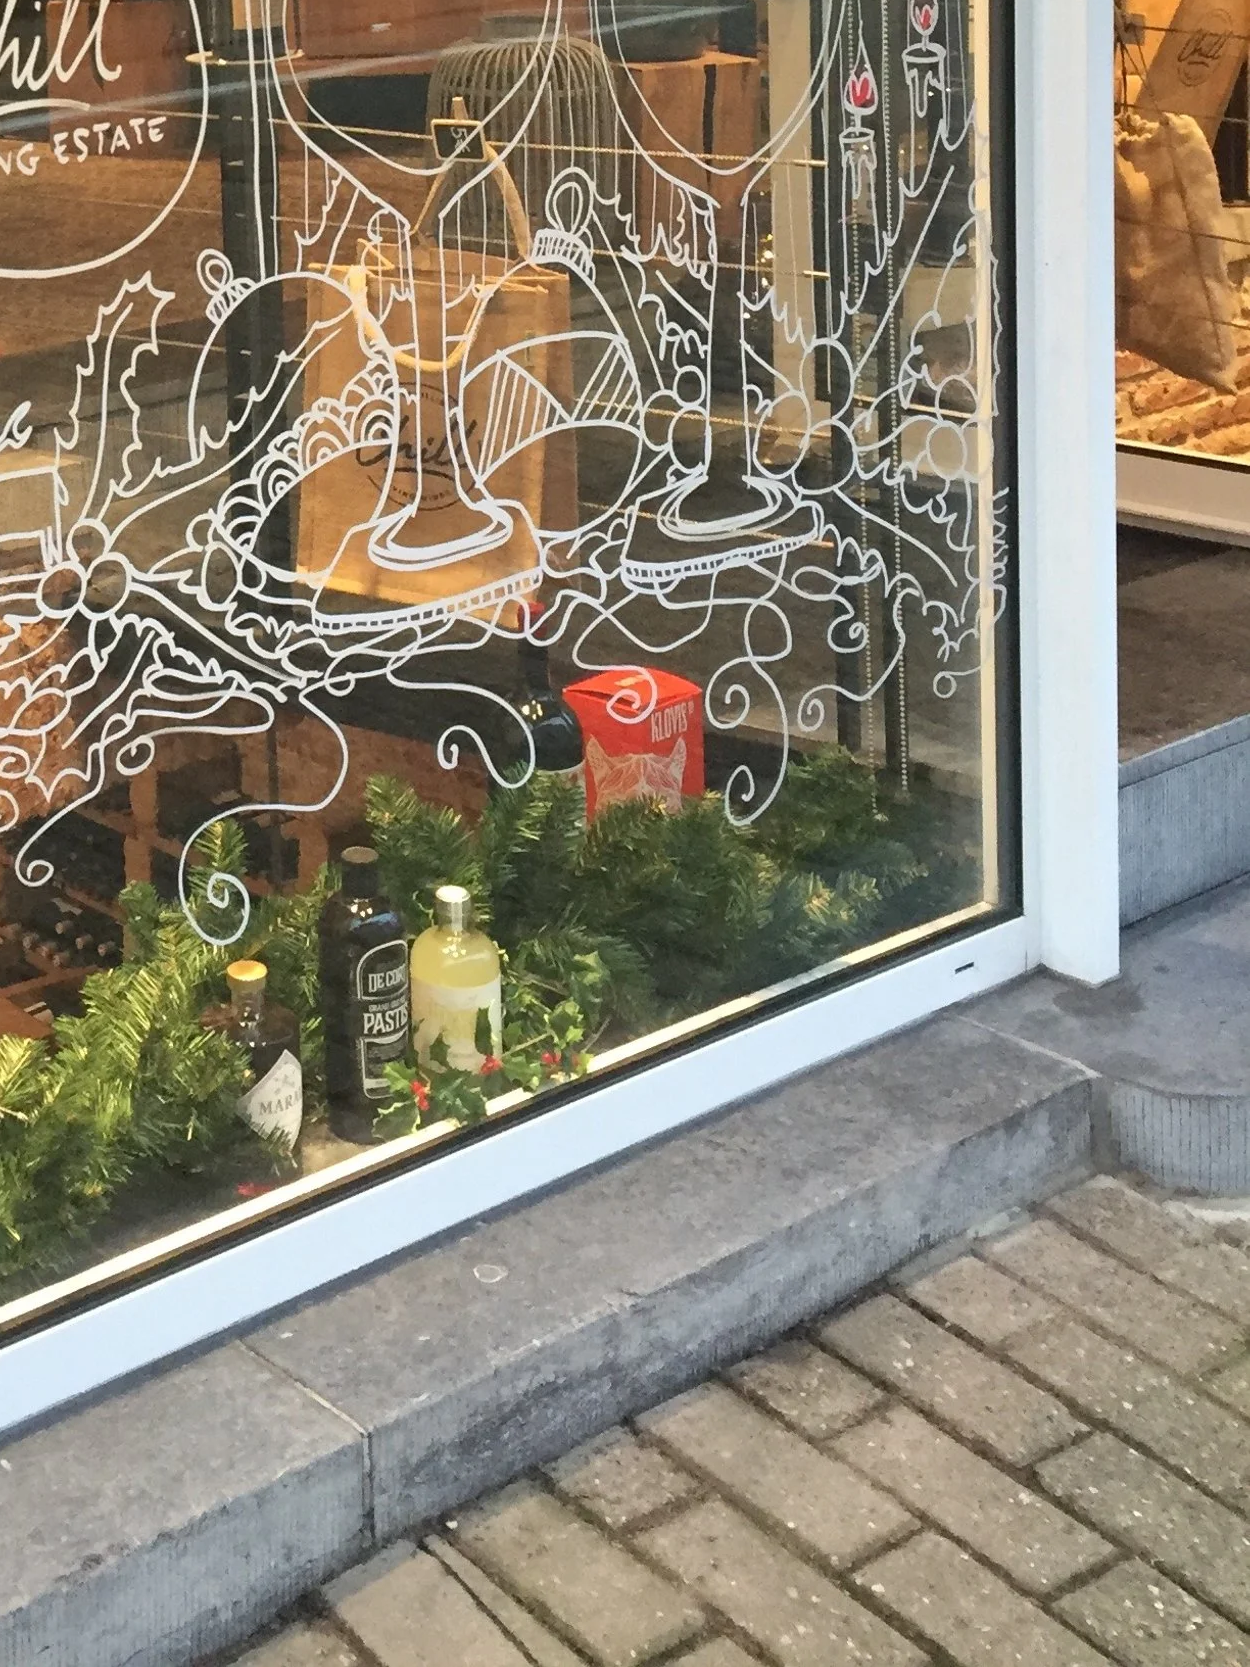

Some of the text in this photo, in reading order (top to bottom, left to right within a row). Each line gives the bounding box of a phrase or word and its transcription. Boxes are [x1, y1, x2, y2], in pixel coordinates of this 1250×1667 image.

[53, 116, 168, 164] ESTATE
[650, 701, 688, 743] KLOVIS
[368, 970, 385, 994] DE
